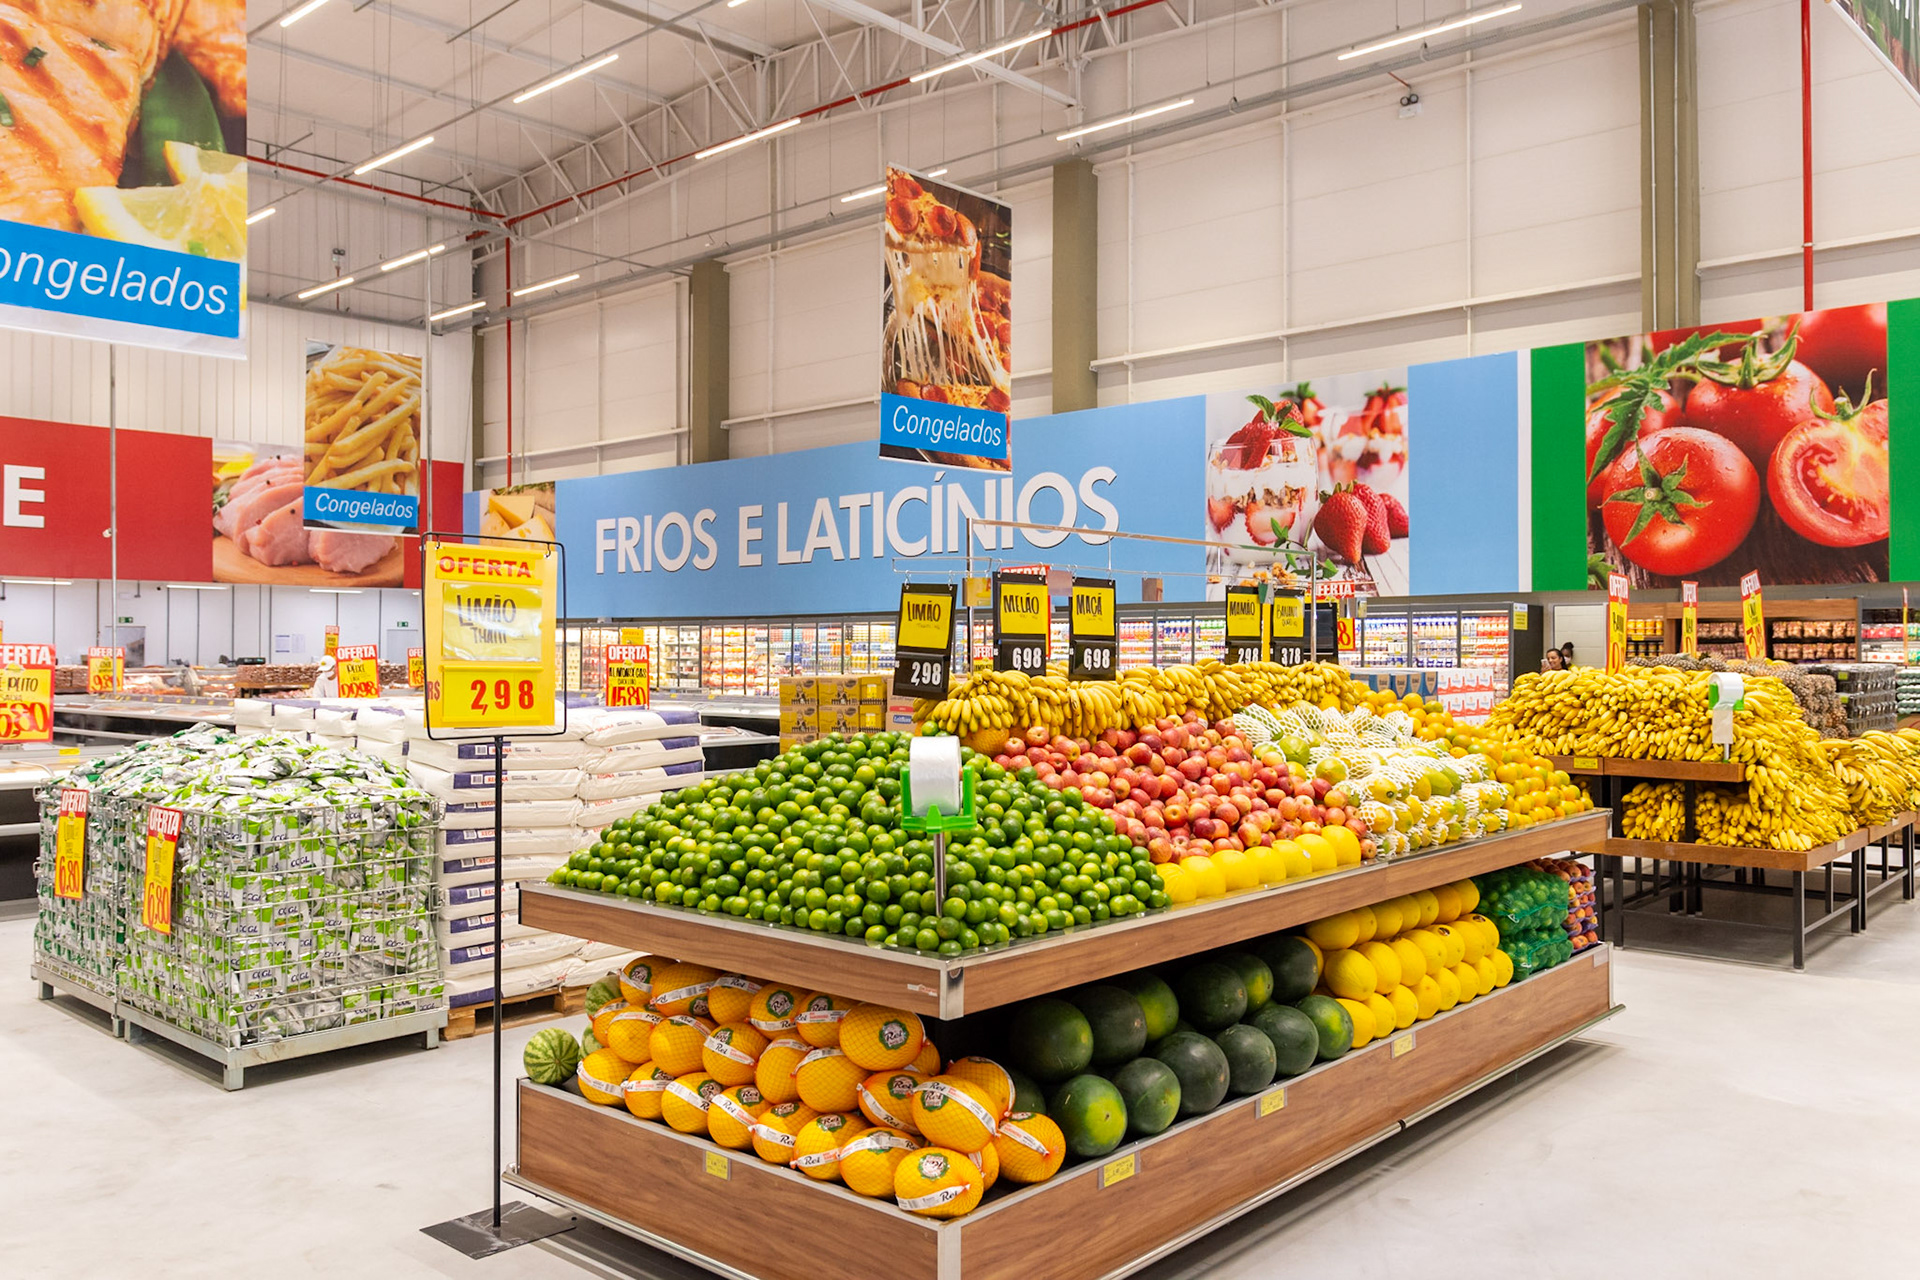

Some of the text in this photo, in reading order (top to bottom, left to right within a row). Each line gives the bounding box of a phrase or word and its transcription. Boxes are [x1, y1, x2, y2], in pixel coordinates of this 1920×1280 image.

[893, 405, 1002, 446] Congelados
[315, 493, 414, 519] Congelados
[596, 465, 1120, 575] FRIOS E LATICÍNIOS
[439, 555, 532, 578] OFERTA
[457, 594, 516, 626] LIMÃO
[90, 647, 123, 657] OFERA
[337, 645, 376, 660] OFERTA
[608, 645, 648, 661] OFERTA
[1012, 647, 1042, 671] 6,98
[1083, 647, 1110, 671] 6,98
[911, 661, 942, 686] 2,98
[470, 679, 535, 715] 2,98
[61, 790, 87, 813] OFERTA
[149, 806, 181, 836] OFERTA
[290, 856, 310, 867] CCGL
[59, 855, 80, 895] 6,80
[147, 881, 170, 928] 6,80
[631, 970, 646, 982] Rei
[730, 978, 746, 988] Rei
[771, 997, 789, 1011] Rei
[885, 1031, 902, 1041] Rei
[716, 1043, 728, 1054] Rei
[894, 1080, 912, 1089] Rei
[929, 1081, 947, 1092] Rei
[742, 1090, 759, 1099] Rei
[722, 1100, 736, 1114] Rei
[823, 1116, 840, 1124] Rei
[884, 1115, 900, 1128] Rei
[804, 1156, 820, 1166] Rei
[939, 1190, 958, 1202] Rei
